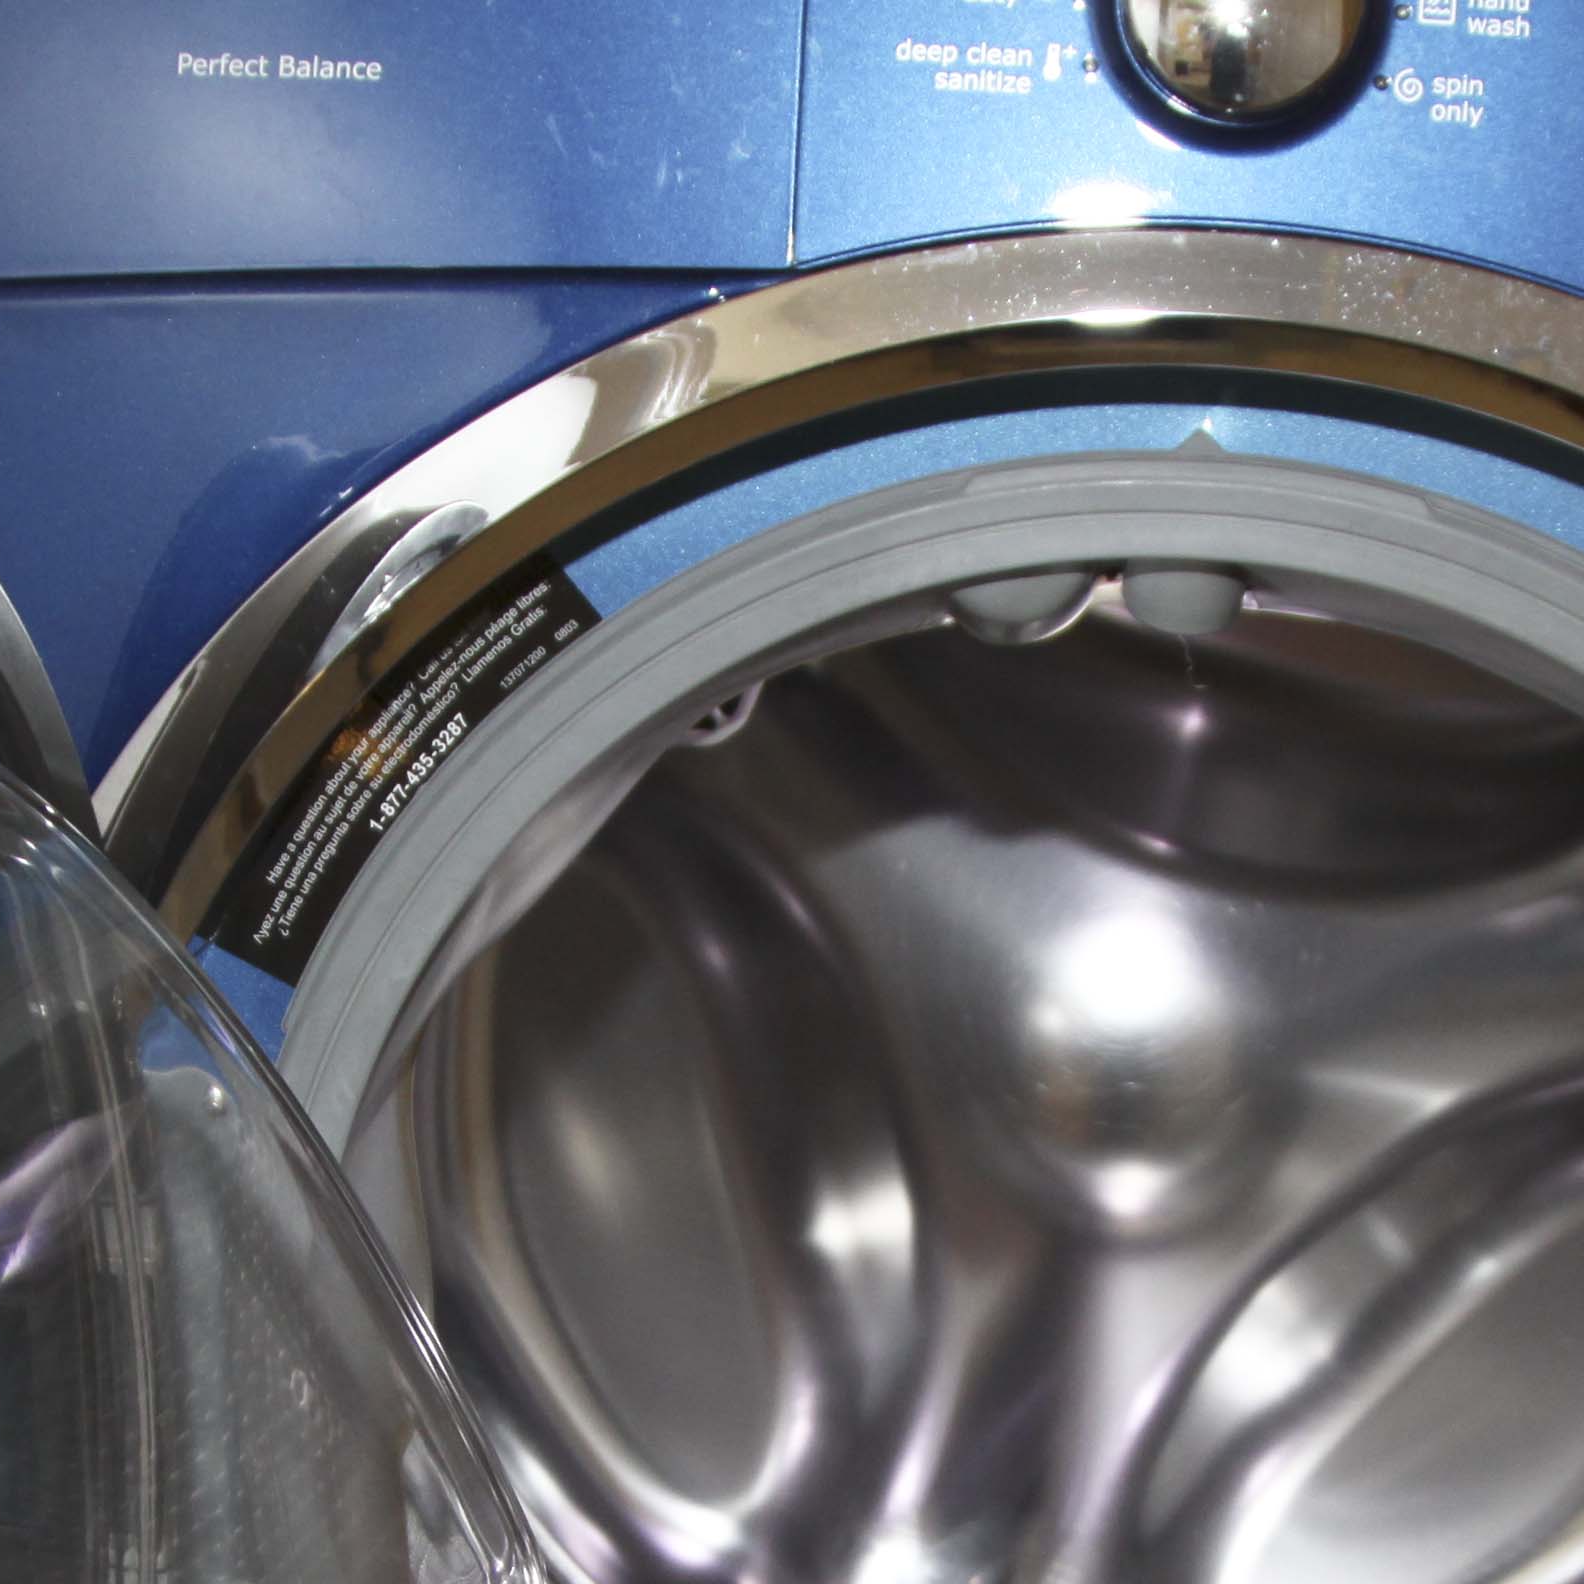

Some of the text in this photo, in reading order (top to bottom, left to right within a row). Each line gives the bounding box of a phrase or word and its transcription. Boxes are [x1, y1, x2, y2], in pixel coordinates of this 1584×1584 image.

[1467, 15, 1530, 37] wash
[177, 52, 382, 80] Perfect Balance
[895, 38, 1033, 67] deep clean
[934, 69, 1032, 94] sanitize
[1431, 74, 1484, 99] spin
[1430, 100, 1484, 128] only
[301, 872, 317, 895] una
[314, 821, 349, 873] pregunta
[346, 789, 373, 822] sobre
[369, 774, 385, 790] su
[461, 634, 513, 683] Llamenos
[369, 712, 468, 832] 1-877-435-3287
[253, 913, 274, 945] Ayez
[271, 890, 288, 914] une
[284, 840, 317, 889] question
[313, 826, 328, 841] au
[324, 795, 348, 825] sujet
[343, 780, 359, 797] de
[356, 752, 379, 781] votre
[377, 703, 419, 754] appareil?
[419, 636, 486, 704] Appelez-nous
[266, 852, 291, 884] Have
[287, 842, 297, 853] a
[292, 795, 328, 845] question
[325, 761, 352, 796] about
[348, 737, 369, 764] your
